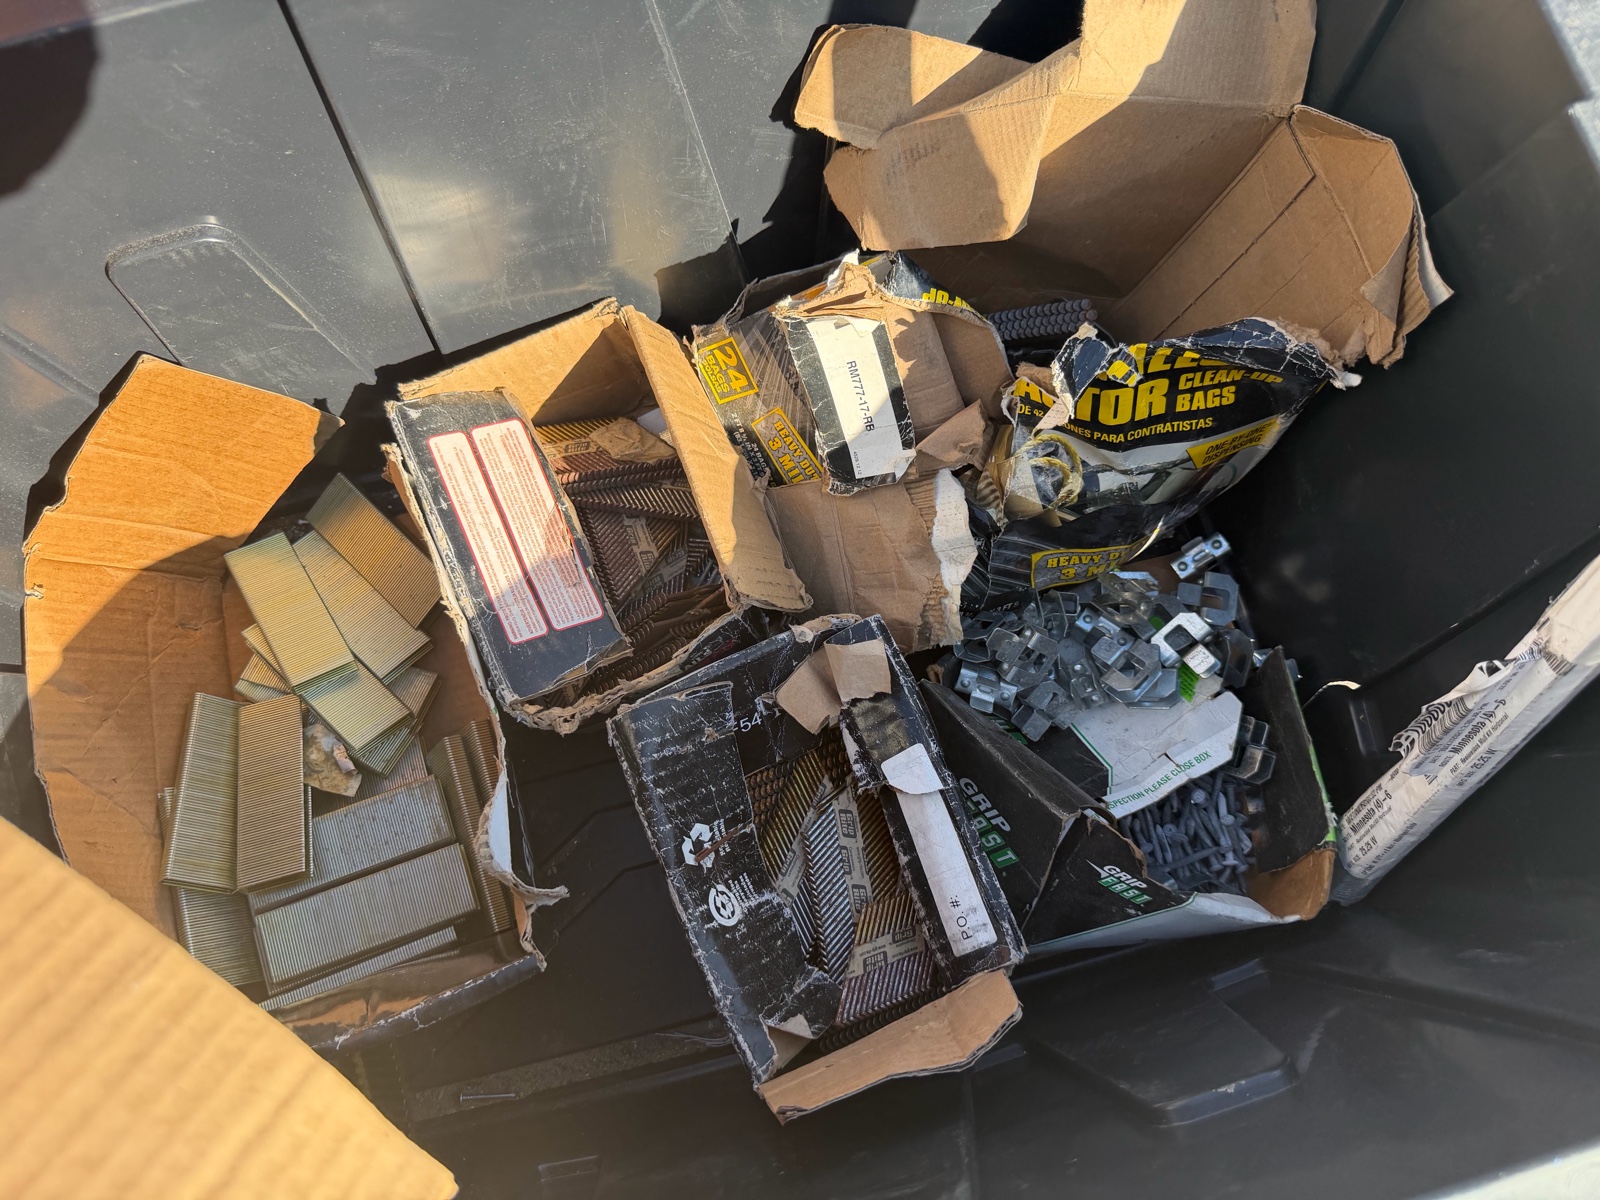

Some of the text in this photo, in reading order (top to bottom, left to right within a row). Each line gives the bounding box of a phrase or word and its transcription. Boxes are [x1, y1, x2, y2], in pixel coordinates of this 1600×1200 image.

[705, 353, 730, 394] BAGS
[712, 342, 750, 395] 24
[1177, 369, 1284, 392] CLEAN-UP
[845, 360, 876, 432] RM777-17-RB
[1175, 385, 1236, 413] BAGS
[766, 436, 782, 452] 3
[1093, 430, 1125, 444] PARA
[1127, 416, 1213, 440] CONTRATISTAS
[750, 441, 759, 451] 24
[772, 419, 820, 482] HEAVY DUT
[1200, 433, 1263, 464] DISPENSING
[1046, 553, 1102, 567] HEAVY
[1059, 567, 1076, 579] 3
[1448, 719, 1486, 756] Minnesota
[1144, 774, 1173, 795] PLEASE
[1169, 757, 1196, 778] CLOSE
[1193, 749, 1211, 764] BOX
[960, 777, 1011, 832] GRIP
[839, 812, 849, 834] Rite
[844, 812, 856, 836] Grip
[1347, 806, 1376, 835] Minnesota
[1099, 876, 1153, 903] FAST
[1103, 865, 1148, 889] GRIP
[956, 911, 973, 940] P.O.
[865, 952, 884, 966] Rite
